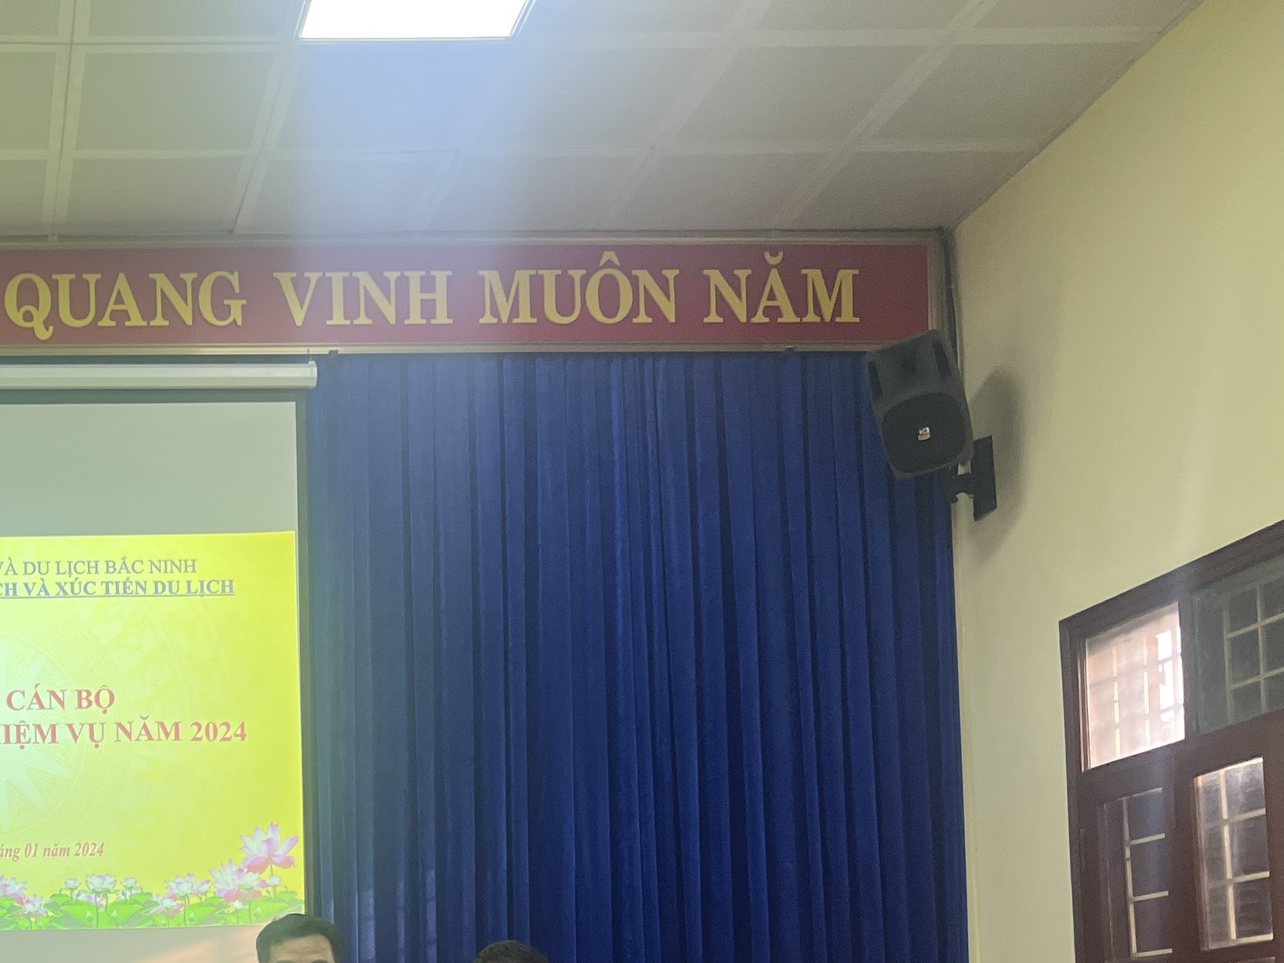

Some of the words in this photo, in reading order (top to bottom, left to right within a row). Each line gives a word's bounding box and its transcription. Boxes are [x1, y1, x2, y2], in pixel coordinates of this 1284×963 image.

[3, 270, 248, 341] QUANG
[273, 268, 454, 326] VINH
[478, 252, 680, 325] MUÔN
[702, 251, 860, 324] NĂM
[23, 561, 51, 575] DU
[55, 560, 100, 578] LỊCH
[104, 555, 144, 575] BẮC
[148, 559, 197, 574] NINH
[22, 578, 51, 597] VÀ
[55, 577, 97, 597] XÚC
[101, 576, 147, 596] TIẾN
[153, 580, 181, 596] DU
[185, 579, 235, 598] LỊCH
[5, 683, 66, 711] CÁN
[74, 685, 116, 715] BỘ
[65, 722, 107, 749] VỤ
[113, 715, 182, 742] NĂM
[189, 721, 248, 742] 2024
[24, 842, 38, 858] 01
[42, 842, 70, 857] năm
[74, 841, 105, 857] 2024
